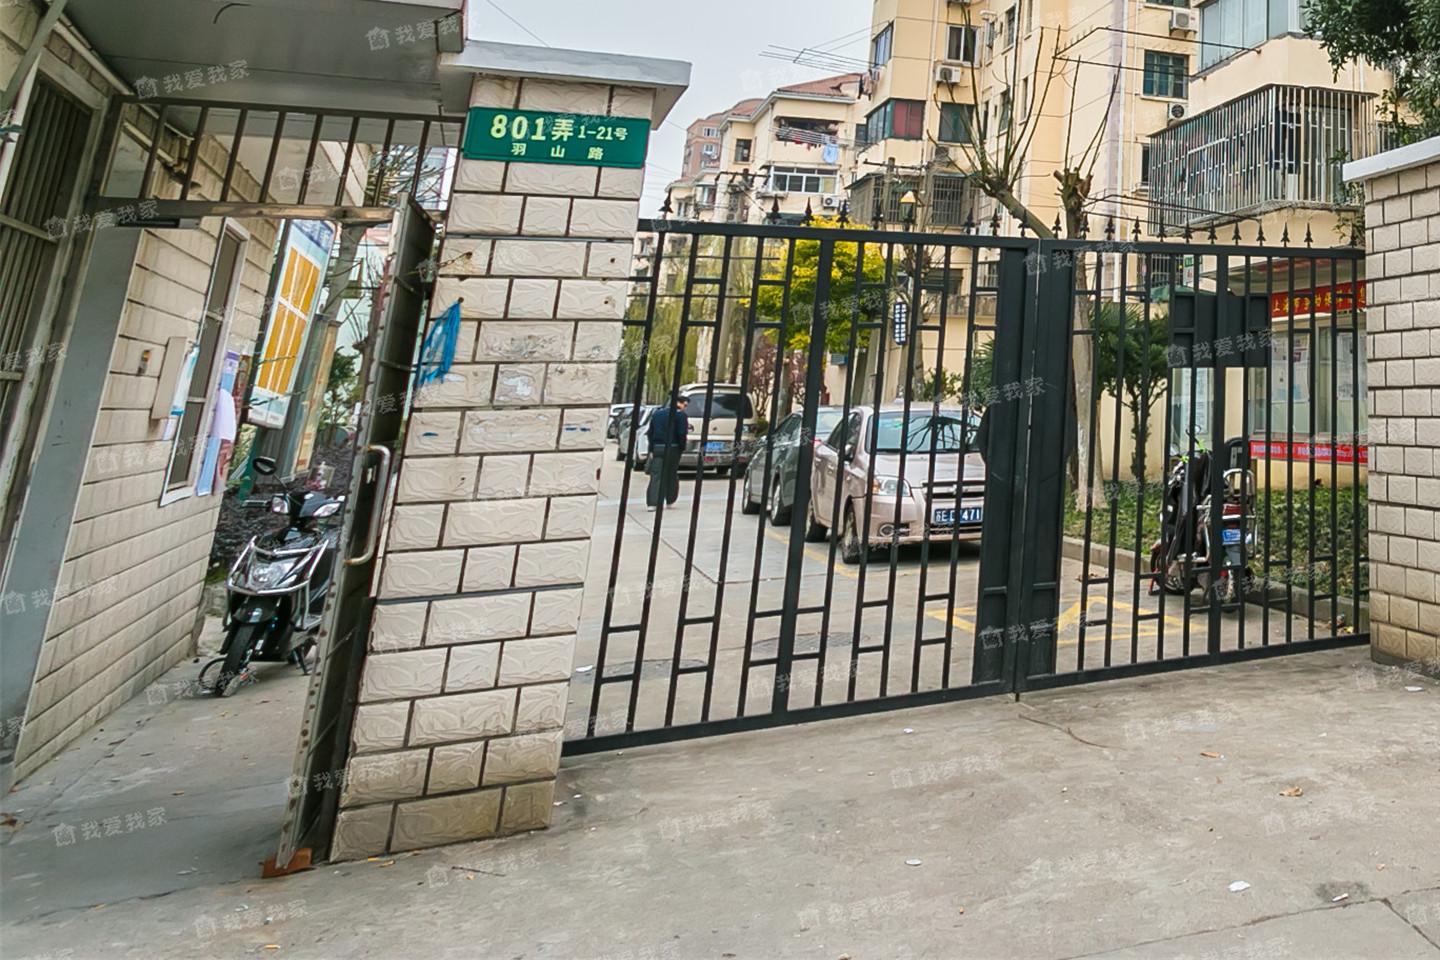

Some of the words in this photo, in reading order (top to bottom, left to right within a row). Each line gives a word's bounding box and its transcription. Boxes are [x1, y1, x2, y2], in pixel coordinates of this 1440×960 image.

[490, 114, 574, 142] 801弄
[578, 125, 628, 140] 1-21号
[511, 142, 604, 160] 羽山路
